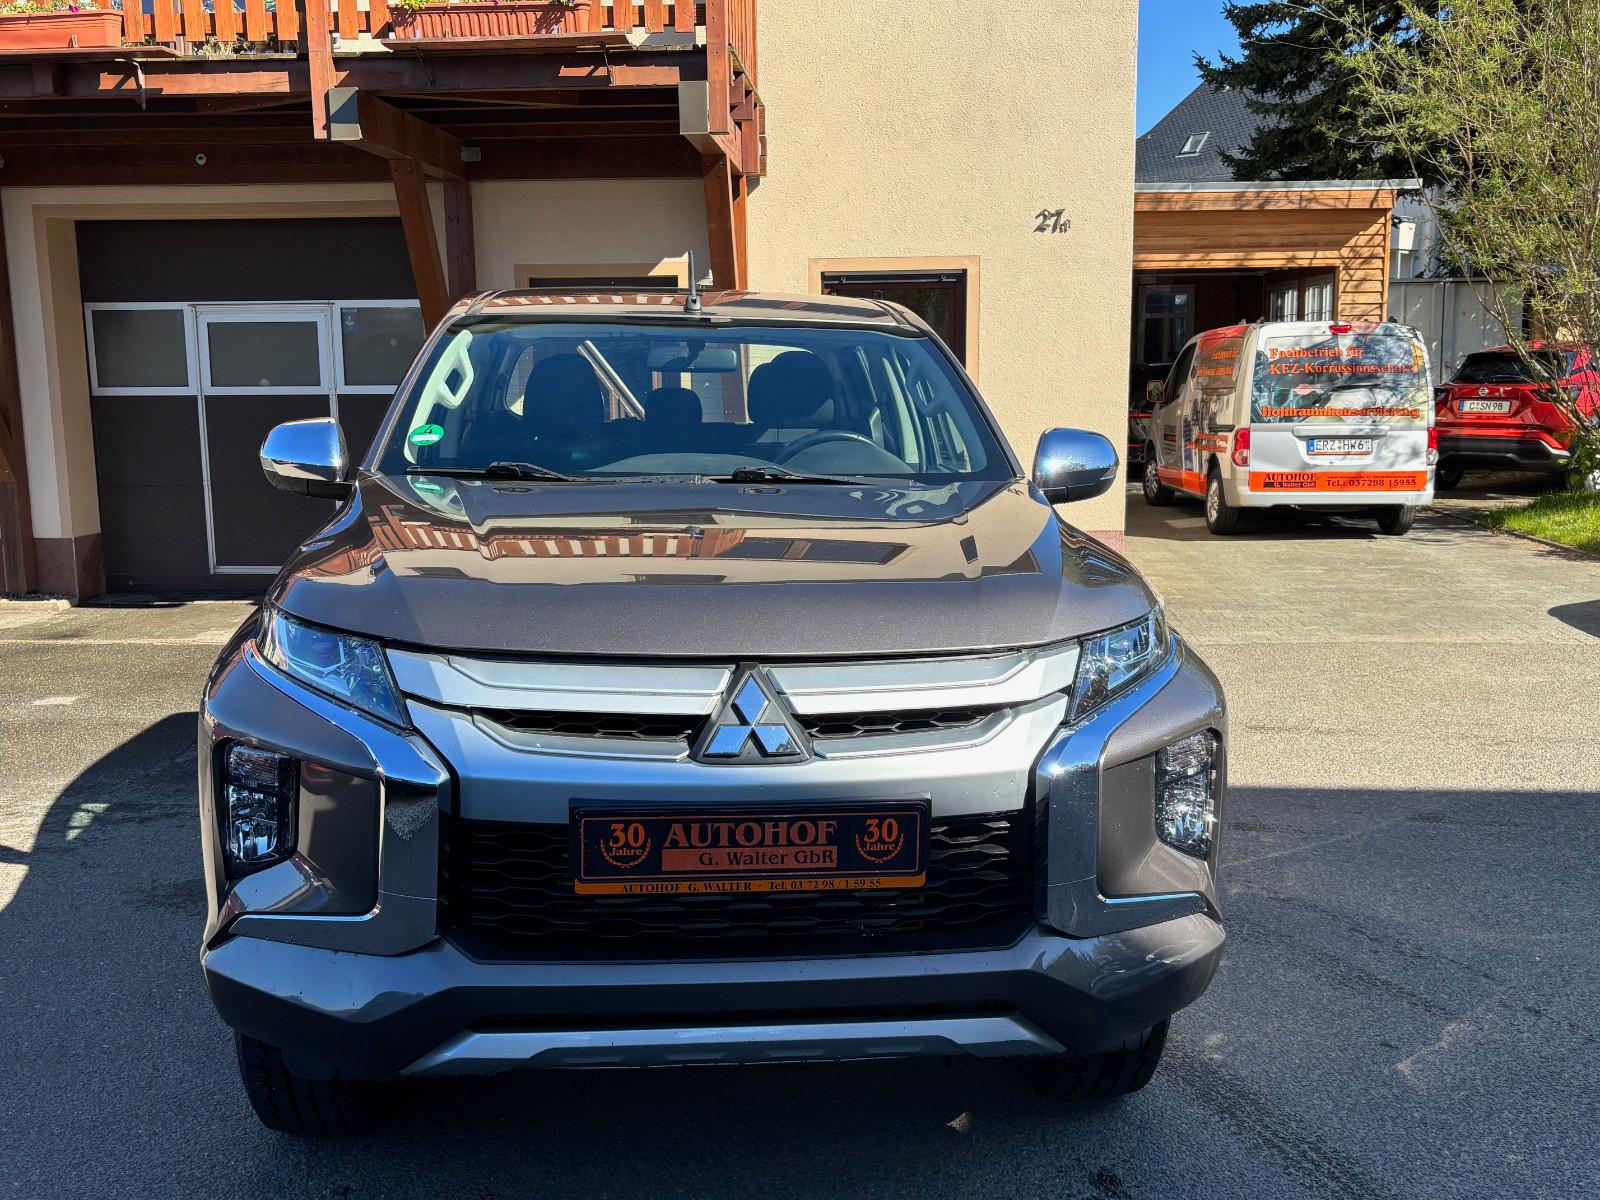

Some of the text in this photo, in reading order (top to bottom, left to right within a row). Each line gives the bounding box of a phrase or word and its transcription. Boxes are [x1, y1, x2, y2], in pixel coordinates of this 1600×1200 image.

[1269, 346, 1343, 359] Fachbetrieb
[424, 425, 433, 434] 4
[1316, 440, 1336, 450] ERZ
[1264, 473, 1317, 481] AUTOHOF
[1348, 479, 1385, 487] 037298
[608, 822, 646, 849] 30
[663, 820, 838, 848] AUTOHOF
[863, 818, 899, 843] 30
[609, 847, 643, 858] Jahre
[864, 841, 896, 853] Jahre
[699, 850, 835, 867] G. Walter GbR
[623, 883, 681, 893] AUTOHOF
[688, 882, 700, 892] G.
[703, 882, 752, 892] WALTER
[768, 881, 787, 890] Tel.
[790, 880, 803, 890] 03
[808, 880, 819, 890] 72
[822, 880, 835, 889] 98
[854, 879, 866, 888] 59
[869, 878, 881, 888] 55
